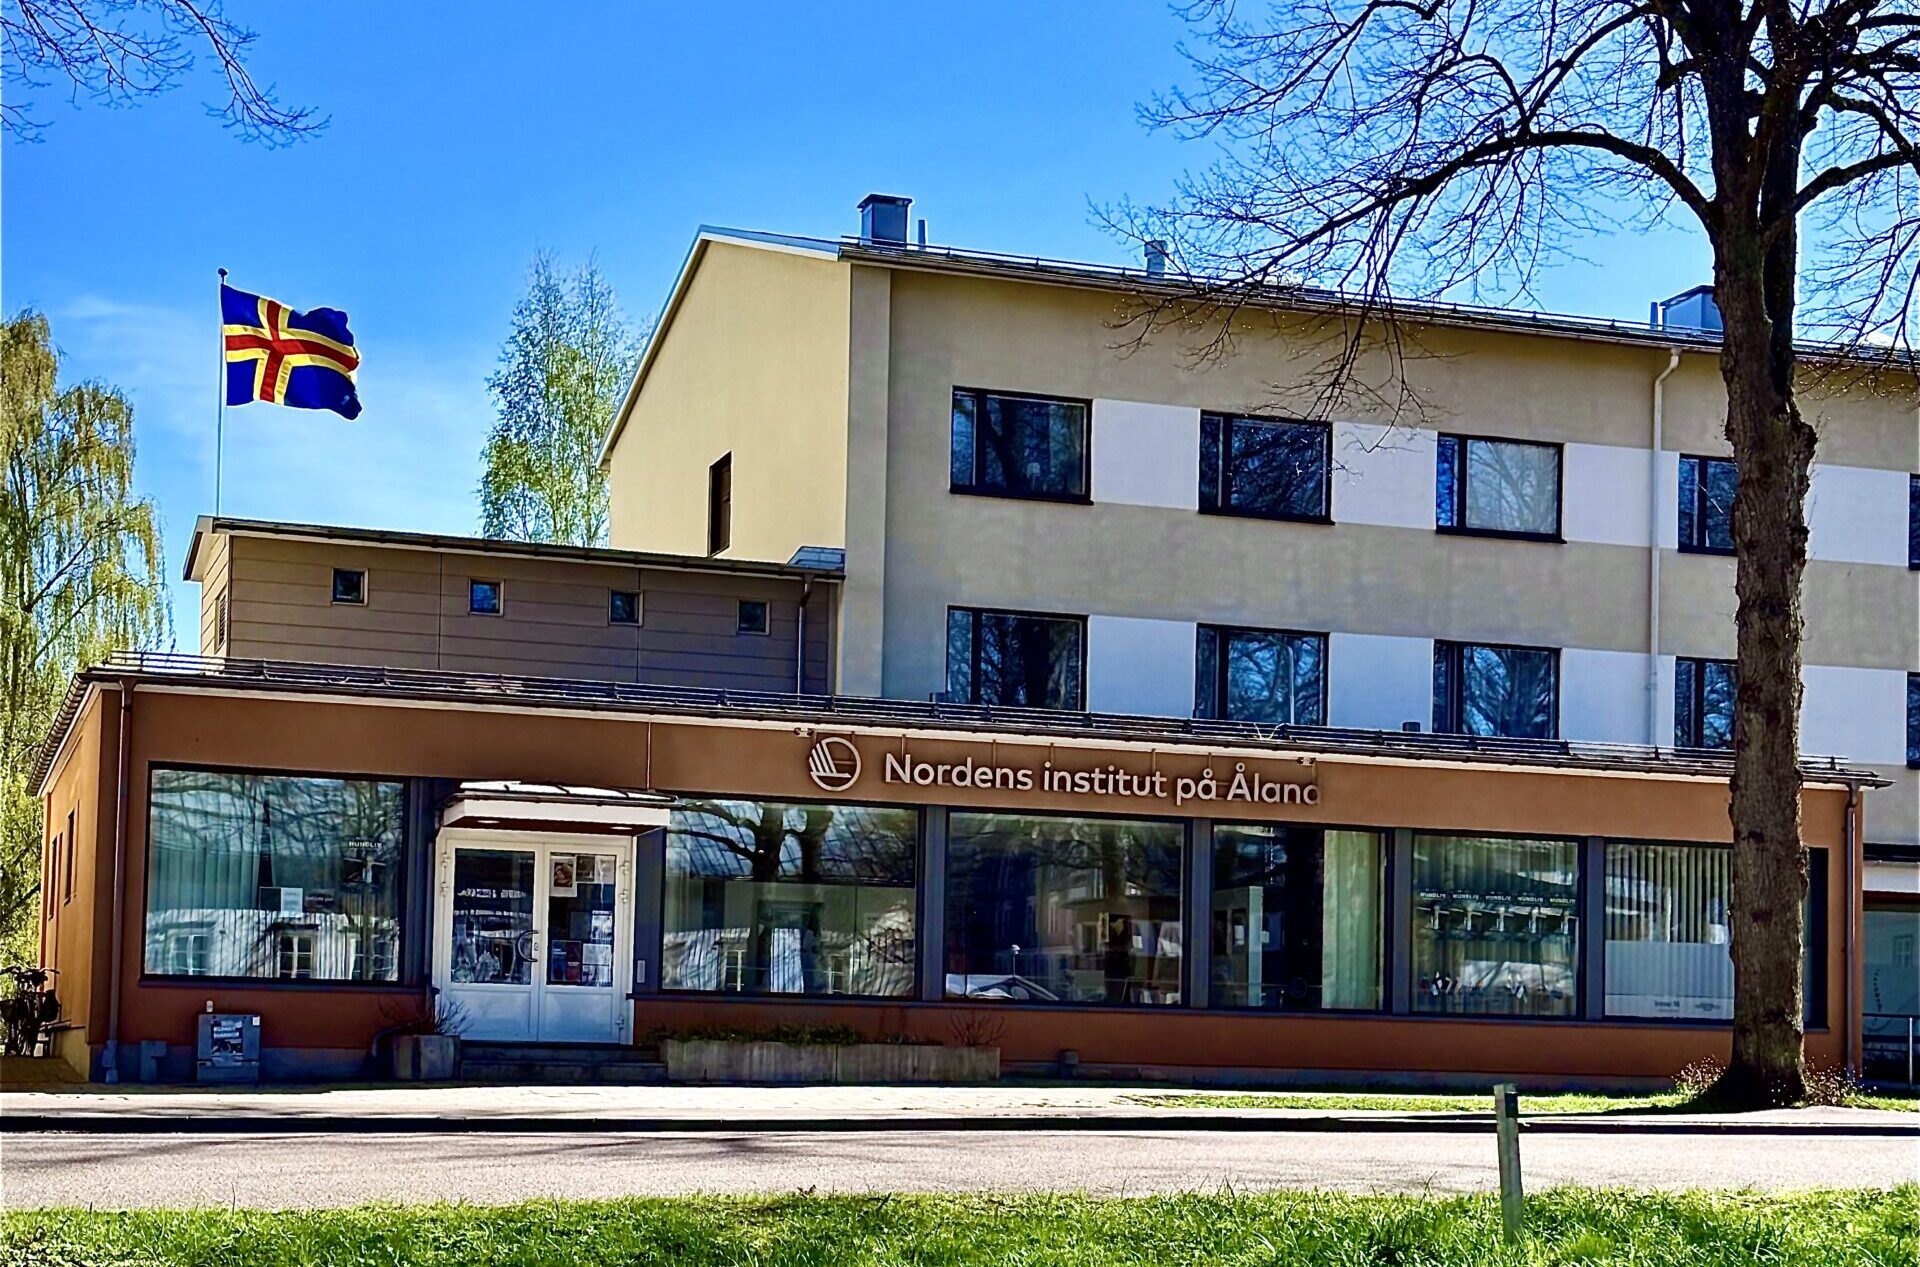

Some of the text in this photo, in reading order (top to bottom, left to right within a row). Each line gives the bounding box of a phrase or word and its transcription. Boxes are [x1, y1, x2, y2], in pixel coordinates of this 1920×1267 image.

[885, 752, 1033, 791] Nordens
[1043, 761, 1168, 798] institut
[1176, 767, 1217, 806] på
